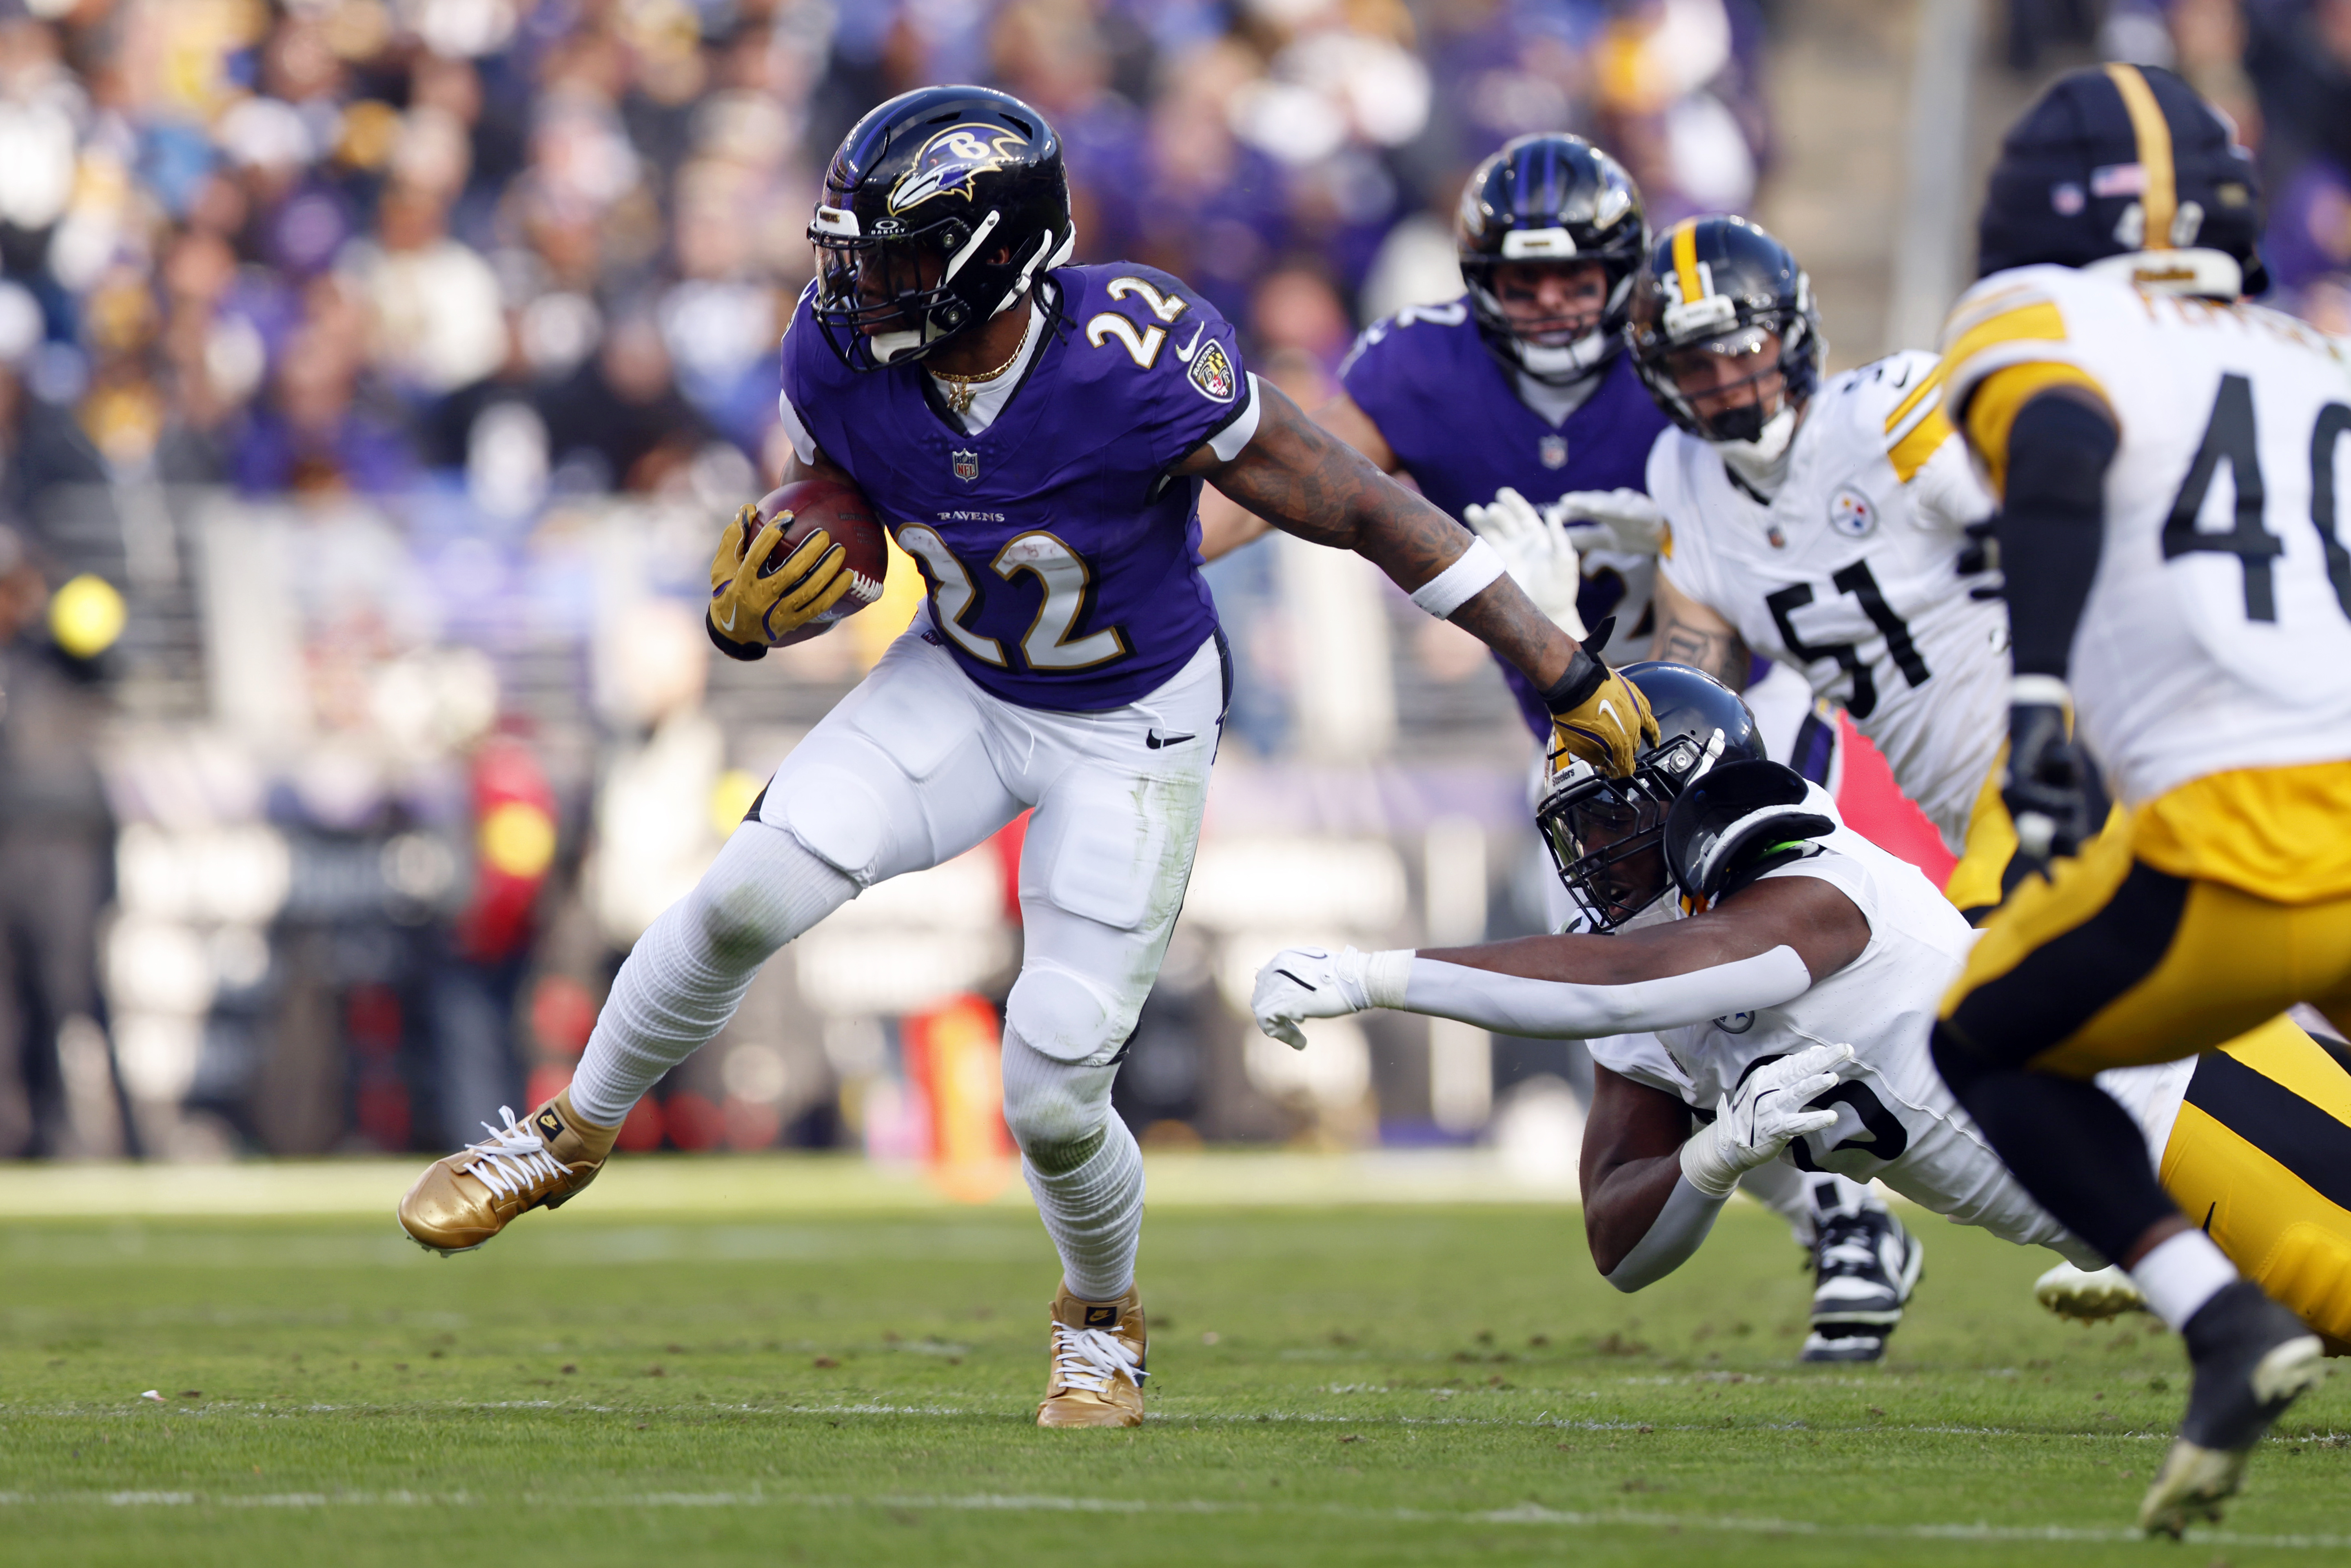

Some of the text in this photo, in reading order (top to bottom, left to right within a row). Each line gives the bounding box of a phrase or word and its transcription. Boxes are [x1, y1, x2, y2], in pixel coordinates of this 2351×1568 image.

[871, 227, 905, 235] OAKLEY
[1085, 276, 1188, 370] 22
[1192, 345, 1215, 377] RAVENS
[957, 464, 976, 476] NFL
[937, 511, 1005, 522] RAVENS
[894, 522, 1128, 670] 22
[1765, 559, 1931, 719] 51
[1552, 768, 1575, 787] Steelers
